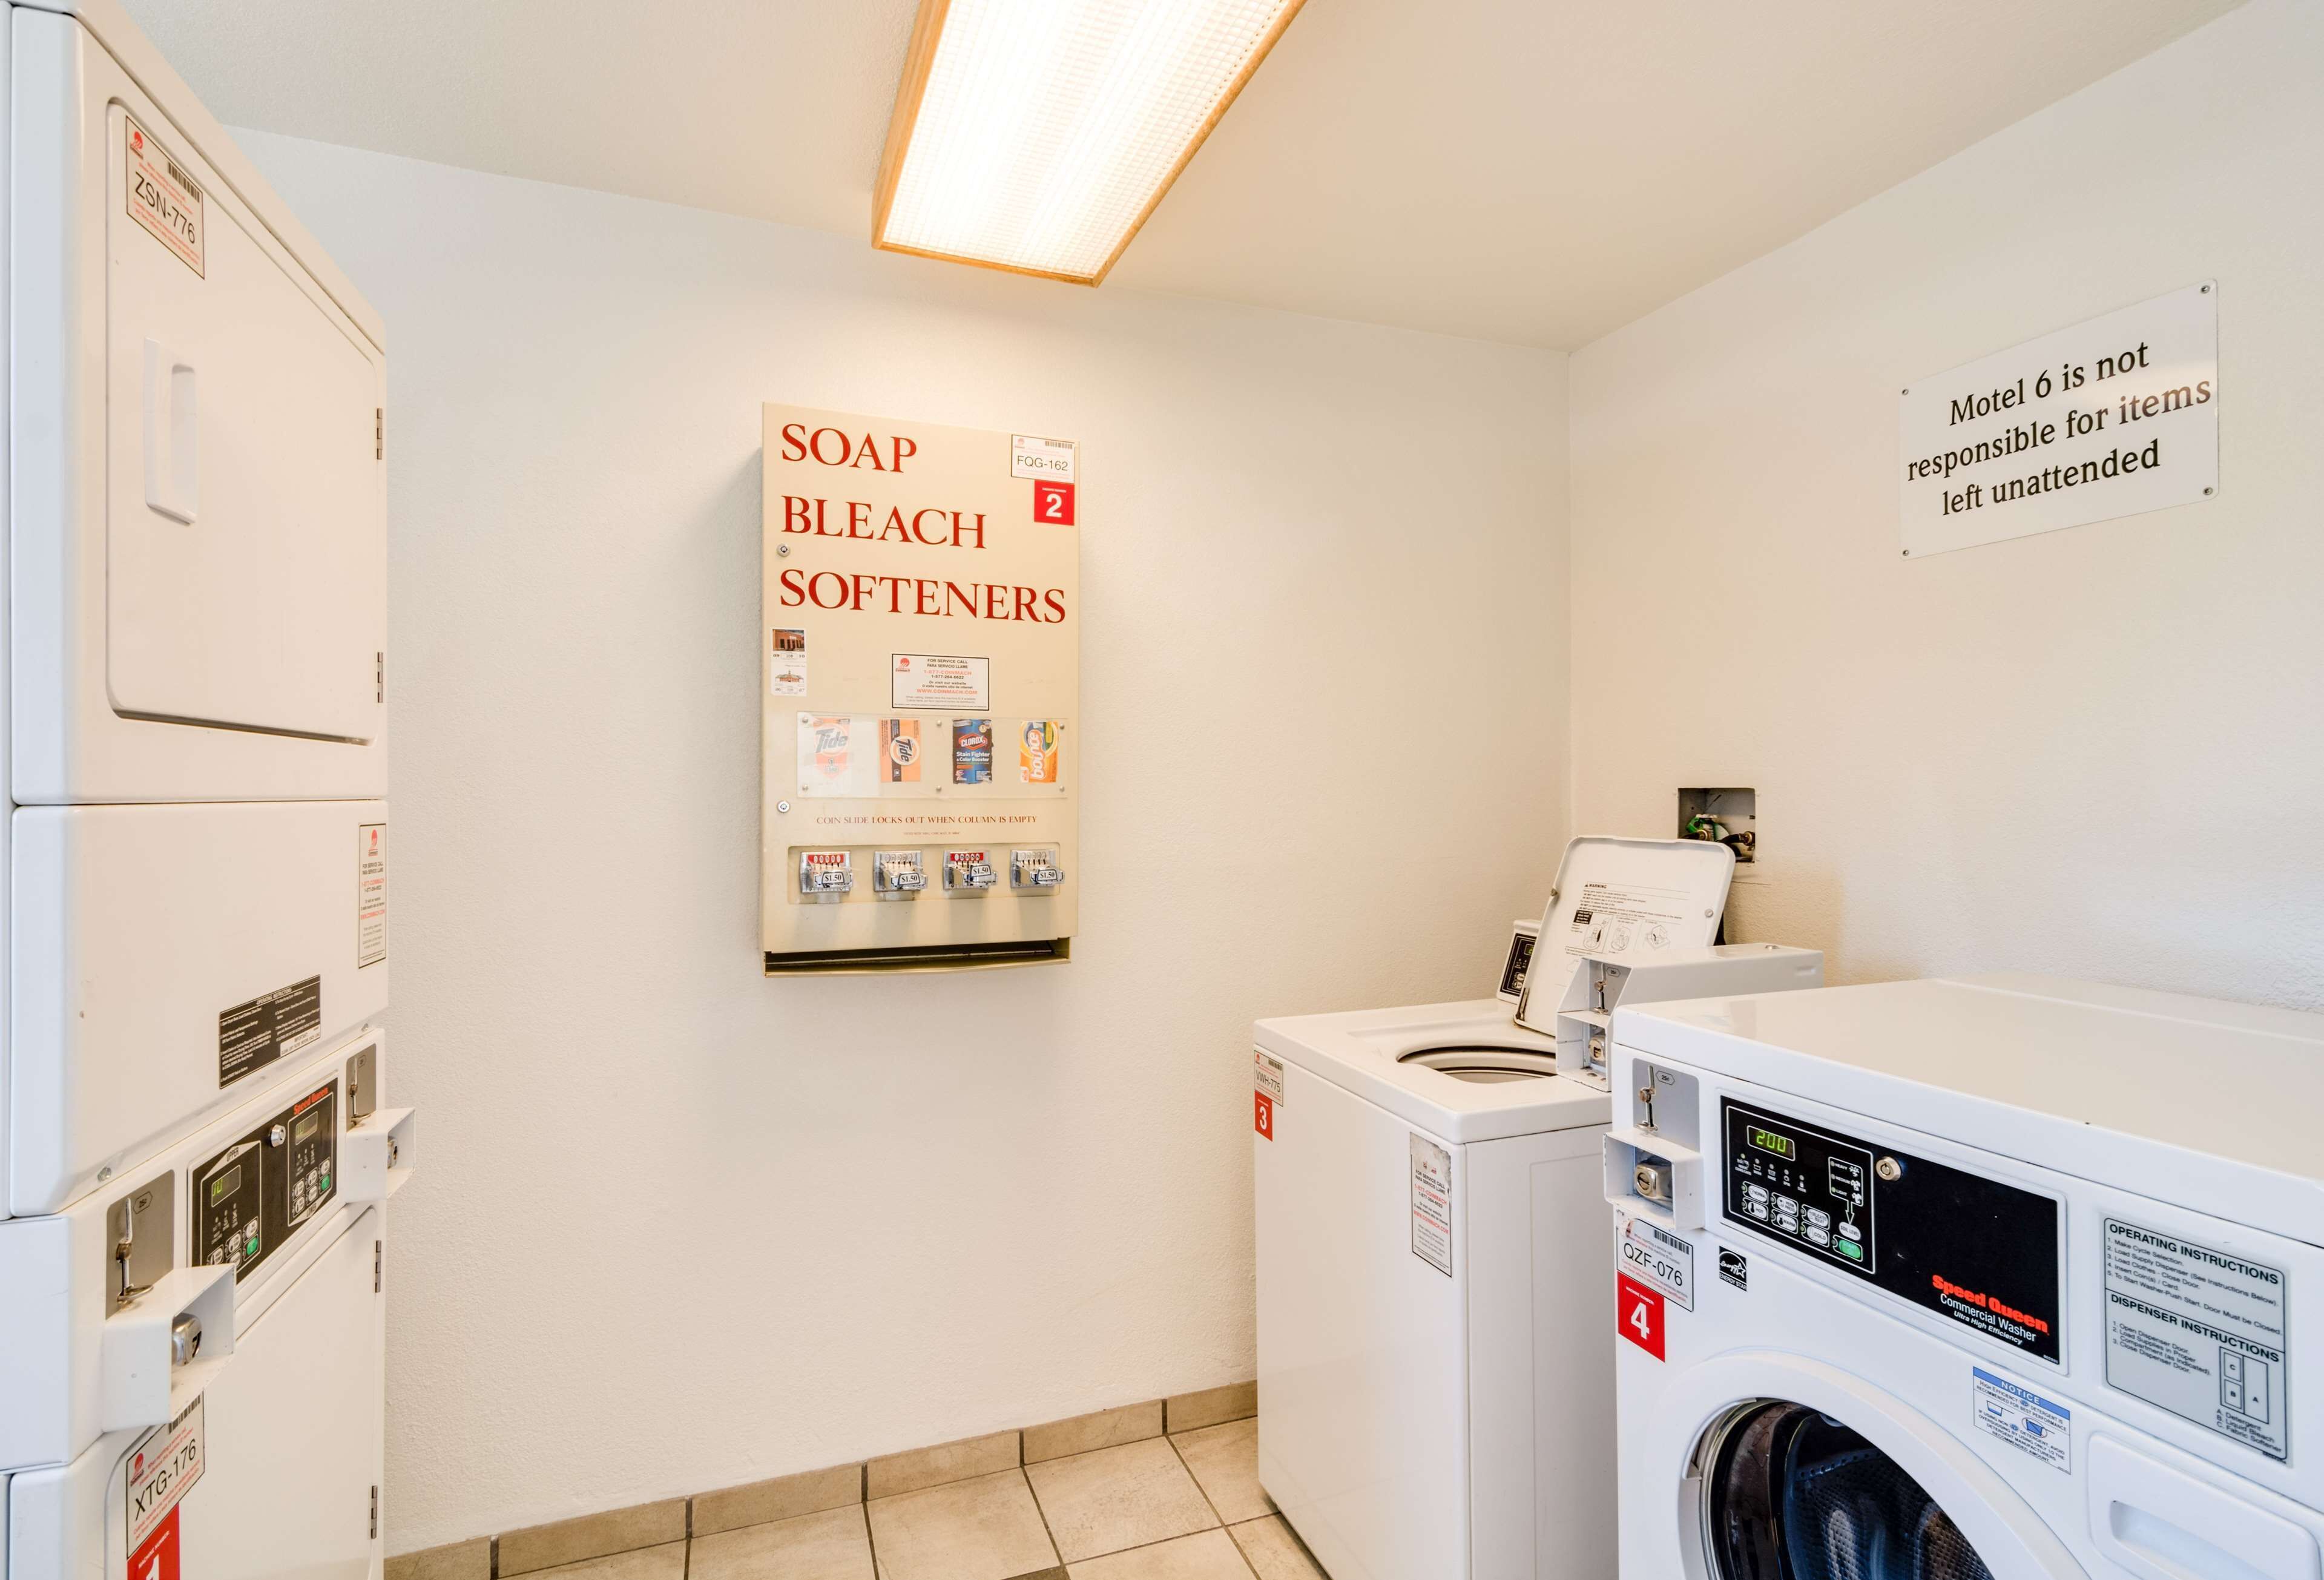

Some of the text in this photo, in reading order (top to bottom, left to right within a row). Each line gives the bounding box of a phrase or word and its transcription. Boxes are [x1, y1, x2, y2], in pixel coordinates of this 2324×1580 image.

[135, 171, 195, 244] ZSN-776
[1949, 342, 2150, 426] Motel 6 is not
[1908, 380, 2212, 481] responsible for items
[781, 424, 917, 473] SOAP
[1017, 455, 1068, 471] FQG-162
[1942, 438, 2161, 516] left unattended
[781, 495, 987, 549] BLEACH
[1046, 493, 1062, 518] 2
[780, 569, 1066, 624] SOFTENERS
[815, 728, 848, 753] Tide
[895, 739, 912, 762] Tide
[1028, 730, 1045, 778] bounce
[1256, 1070, 1280, 1093] VWH-775
[294, 1087, 328, 1114] Speed Queen
[1260, 1106, 1267, 1130] 3
[226, 1147, 239, 1162] UPPER
[1757, 1130, 1786, 1153] 200
[1624, 1243, 1682, 1286] QZF-076
[2110, 1224, 2279, 1285] OPERATING INSTRUCTIONS
[2115, 1240, 2184, 1266] Make Cycle Selection.
[1719, 1273, 1746, 1290] ENERGY STAR
[2115, 1256, 2200, 1289] Load Clothes Close Door.
[2115, 1248, 2279, 1306] Load Supply Dispenser (See Instructions Below).
[2115, 1265, 2179, 1291] Insert Coin(s) Card.
[1631, 1302, 1650, 1340] 4
[1932, 1274, 2049, 1333] Speed Queen
[1940, 1293, 2036, 1341] Commercial Washer
[2124, 1276, 2138, 1285] Start
[2139, 1281, 2182, 1300] Washer-Push
[2184, 1297, 2201, 1307] Start.
[2204, 1303, 2220, 1314] Door
[2223, 1310, 2240, 1321] Must
[2254, 1321, 2283, 1336] Closed.
[1954, 1310, 2023, 1345] Ultra High Efficiency
[2112, 1294, 2279, 1362] DISPENSER INSTRUCTIONS
[2119, 1323, 2190, 1354] Open Dispenser Door.
[2119, 1329, 2135, 1340] Load
[2137, 1336, 2164, 1351] Supplies
[2173, 1350, 2196, 1363] Proper
[2119, 1335, 2211, 1375] Compartment (as Indicated).
[2119, 1341, 2191, 1374] Close Dispenser Door.
[1977, 1385, 2009, 1404] RECOMMENDED
[2032, 1412, 2066, 1431] PERFORMANCE
[1980, 1380, 1991, 1389] HIGH
[1992, 1386, 2018, 1402] EFFICIENCY
[2030, 1406, 2058, 1421] DETERGENT
[2001, 1381, 2040, 1405] NOTICE
[1983, 1412, 1997, 1421] USING
[2050, 1446, 2065, 1455] AVOID
[2225, 1412, 2262, 1432] Detergent
[2225, 1418, 2274, 1443] Liquid Bleach
[2226, 1425, 2282, 1452] Fabric Softener
[1987, 1423, 2056, 1461] DETERGENT MANUFACTURERS
[1992, 1430, 2027, 1452] RECOMMENDED
[2020, 1435, 2033, 1444] USING
[2034, 1442, 2047, 1450] ONLY
[136, 1438, 196, 1521] XTG-176
